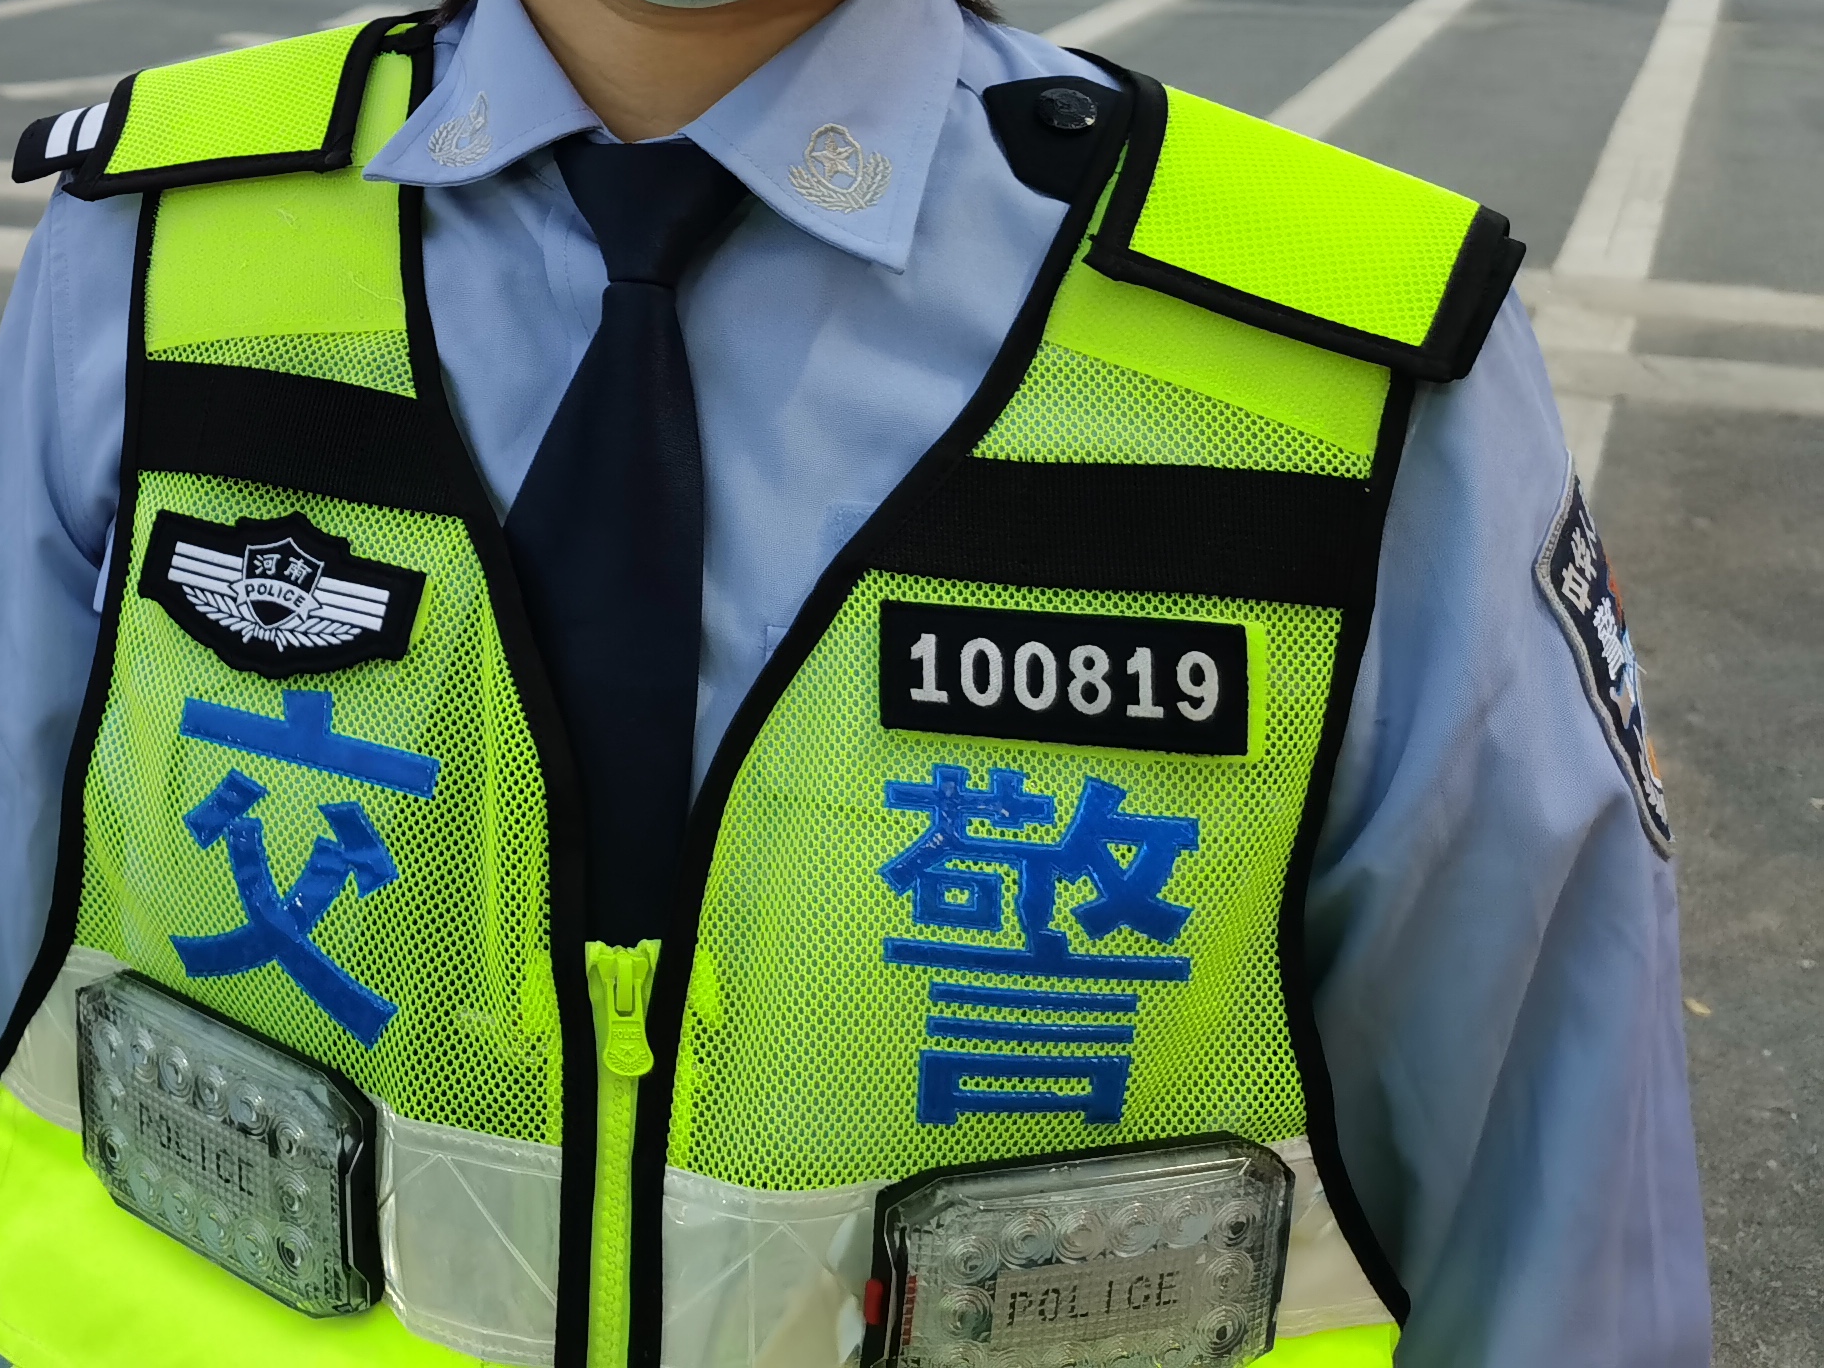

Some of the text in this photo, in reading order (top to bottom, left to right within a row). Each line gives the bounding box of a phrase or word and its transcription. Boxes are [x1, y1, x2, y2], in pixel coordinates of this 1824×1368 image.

[244, 580, 307, 609] POLICE
[253, 552, 313, 586] 河南
[908, 632, 1220, 722] 100819
[168, 689, 1200, 1126] 交 警
[137, 1099, 255, 1197] POLICE
[1006, 1270, 1182, 1327] POLICE
